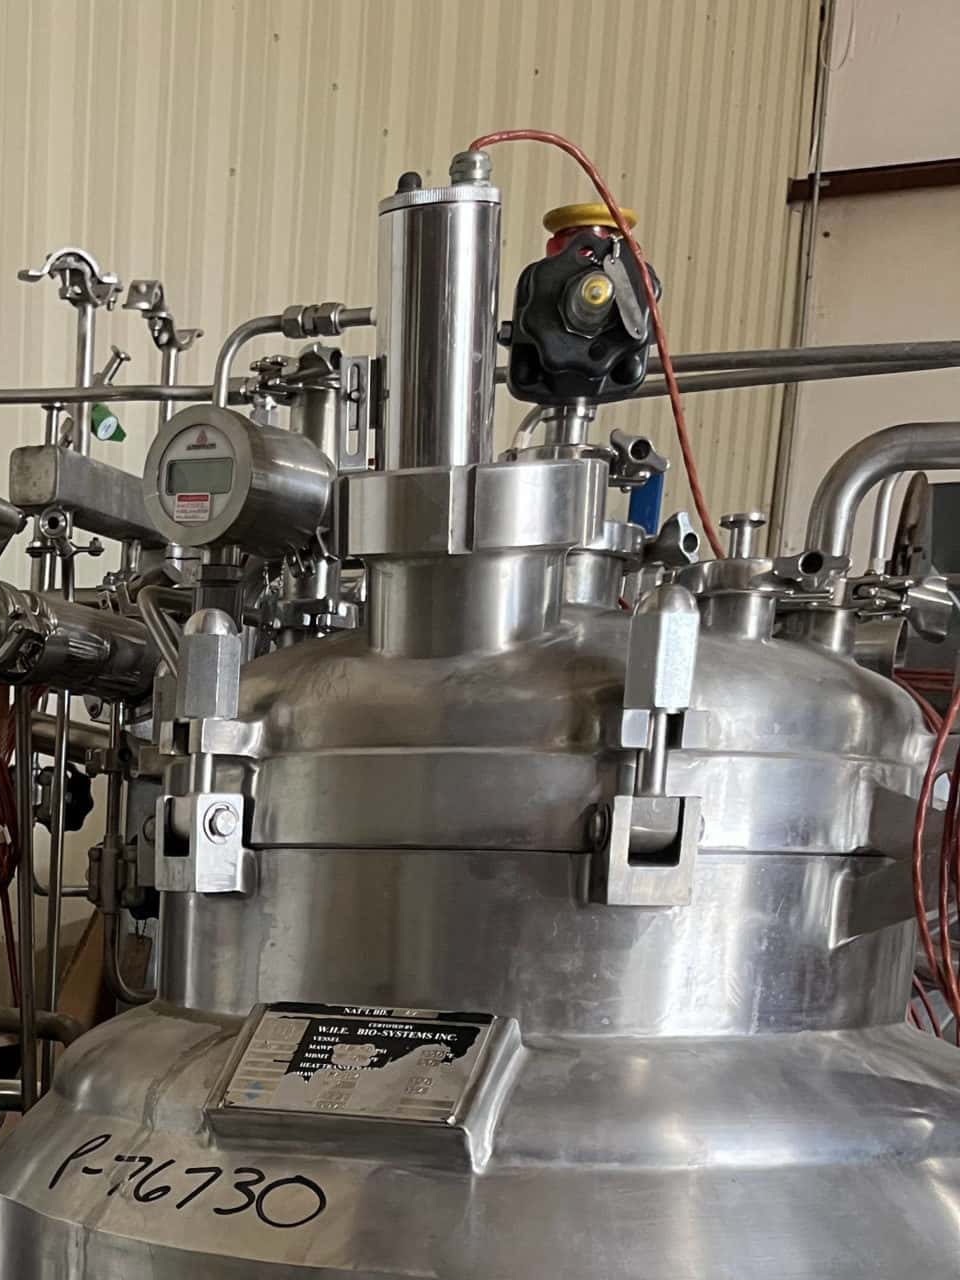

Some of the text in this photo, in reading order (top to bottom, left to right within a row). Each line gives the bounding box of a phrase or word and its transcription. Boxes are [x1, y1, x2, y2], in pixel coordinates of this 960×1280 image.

[357, 1028, 432, 1040] BIO-SYSTEMS
[434, 1033, 458, 1041] INC.
[48, 1133, 327, 1228] P-76730
